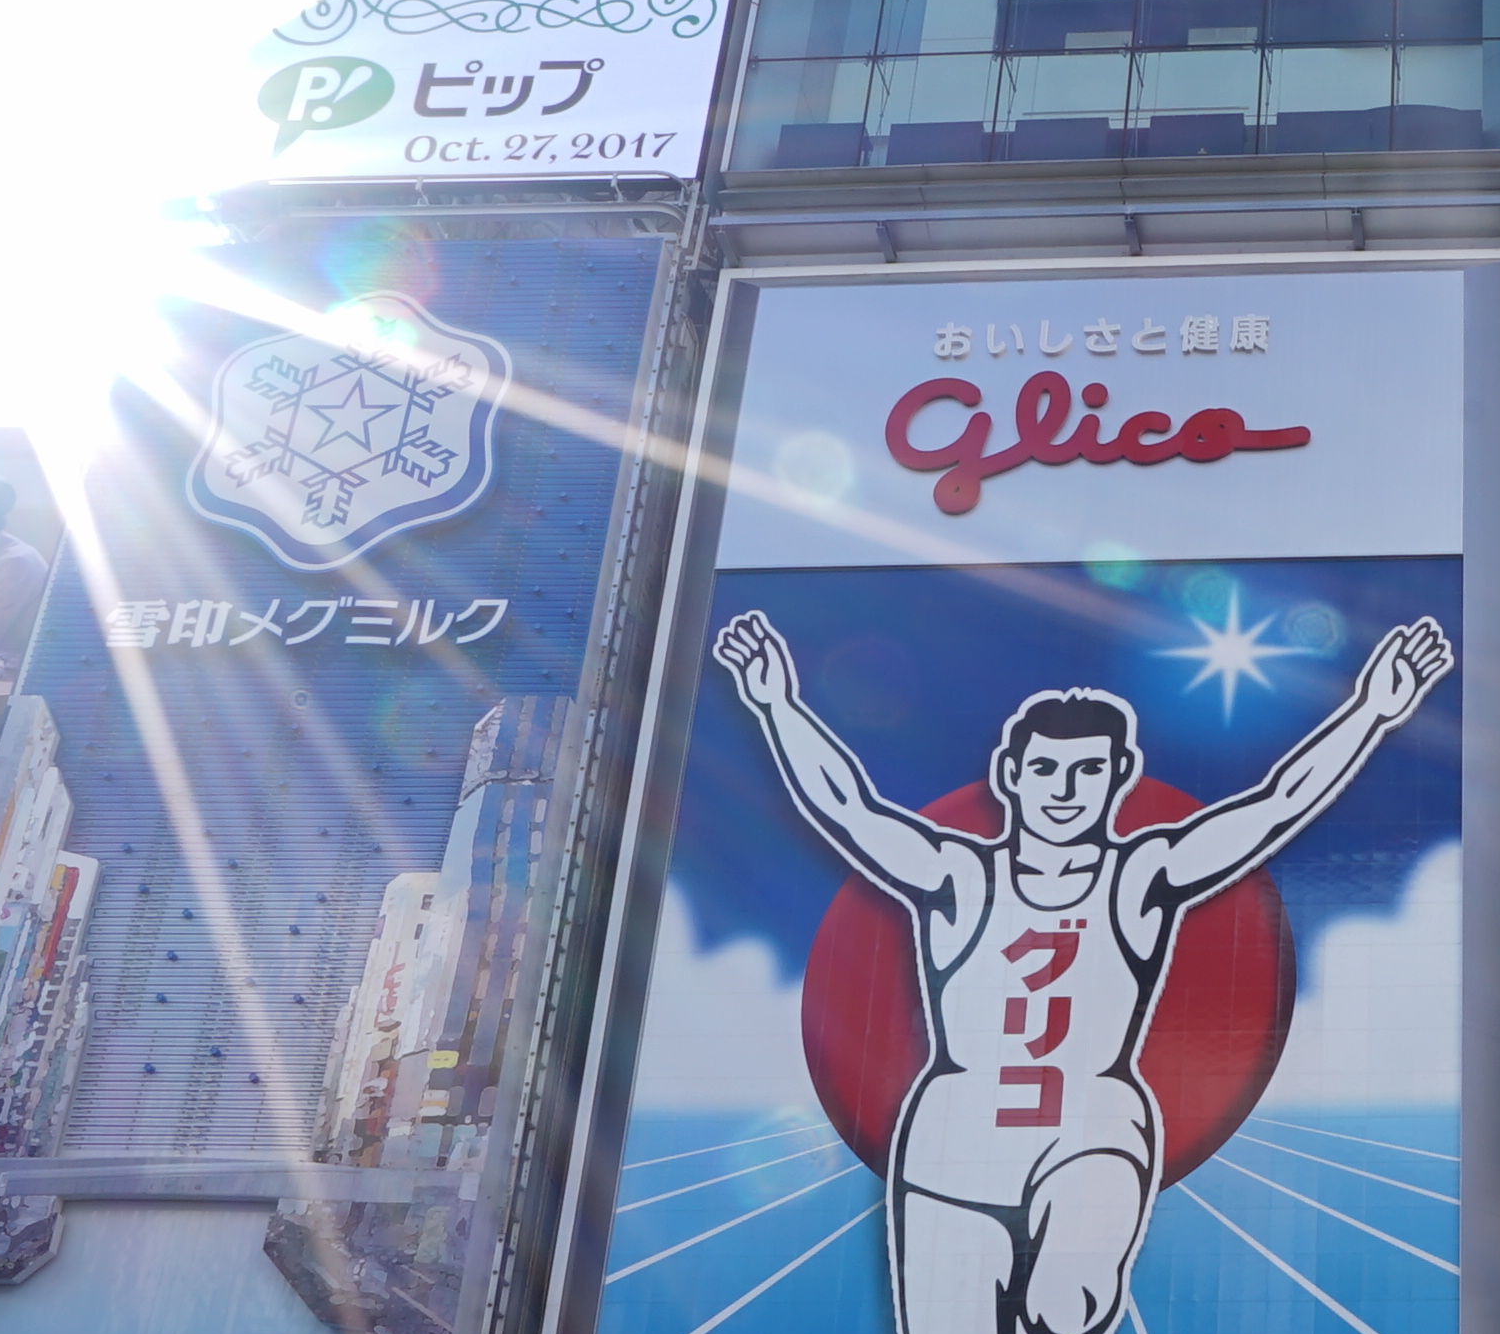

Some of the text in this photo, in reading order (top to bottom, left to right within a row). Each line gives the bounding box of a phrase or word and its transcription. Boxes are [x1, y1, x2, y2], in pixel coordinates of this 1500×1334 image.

[412, 57, 605, 118] ピップ
[405, 132, 679, 165] Oct. 27, 2017
[933, 314, 1271, 359] おいしさと健康
[105, 598, 509, 648] 雪印メグミルク
[995, 919, 1088, 1128] グリコ
